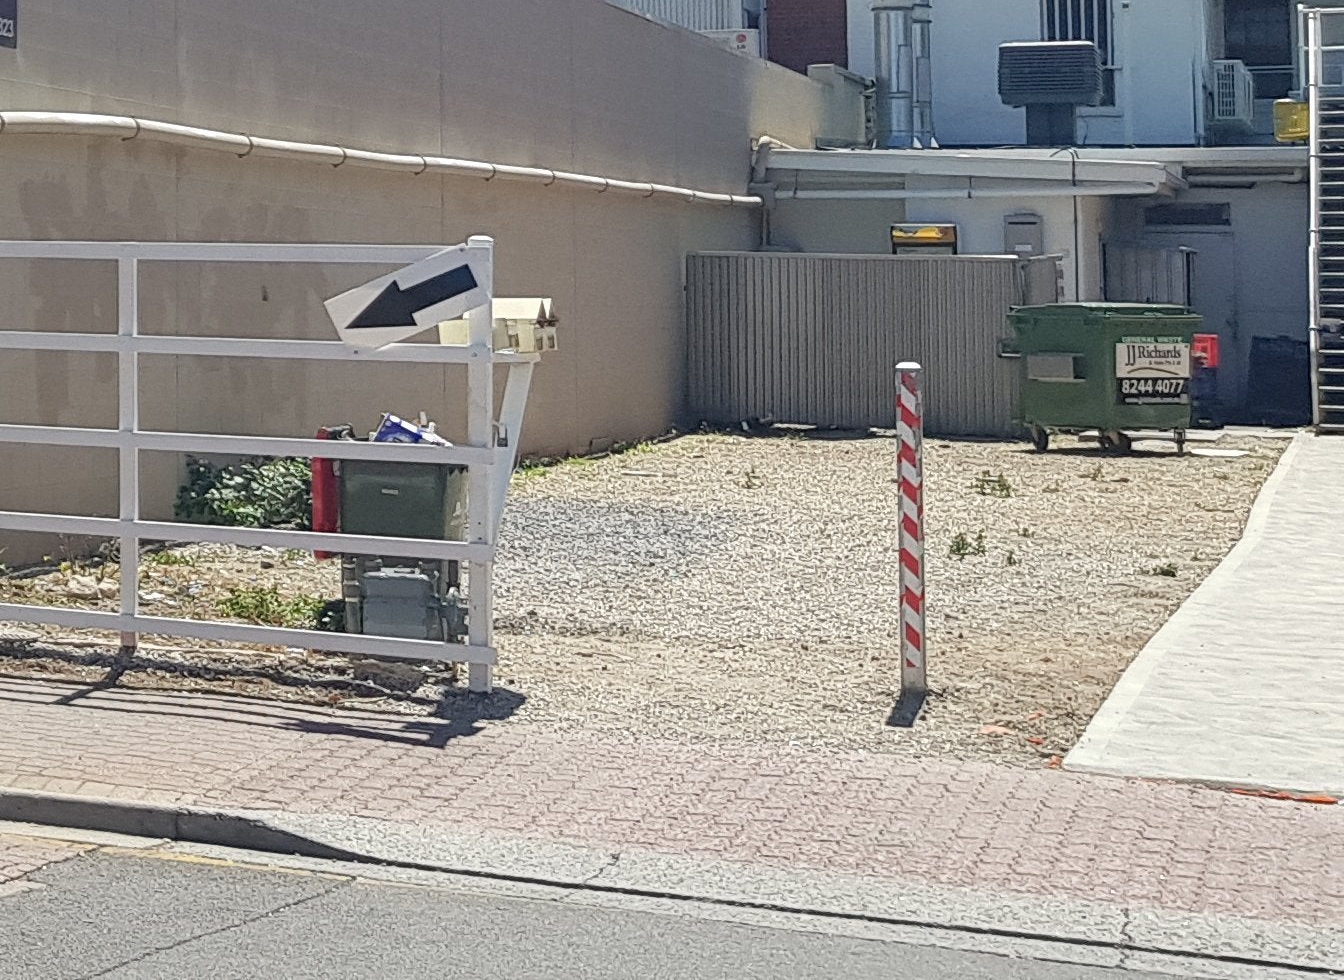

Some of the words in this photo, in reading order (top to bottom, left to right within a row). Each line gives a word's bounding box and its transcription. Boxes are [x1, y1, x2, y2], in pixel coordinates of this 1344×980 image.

[1137, 345, 1181, 359] Richards
[1122, 380, 1153, 394] 8244
[1154, 380, 1184, 394] 4077
